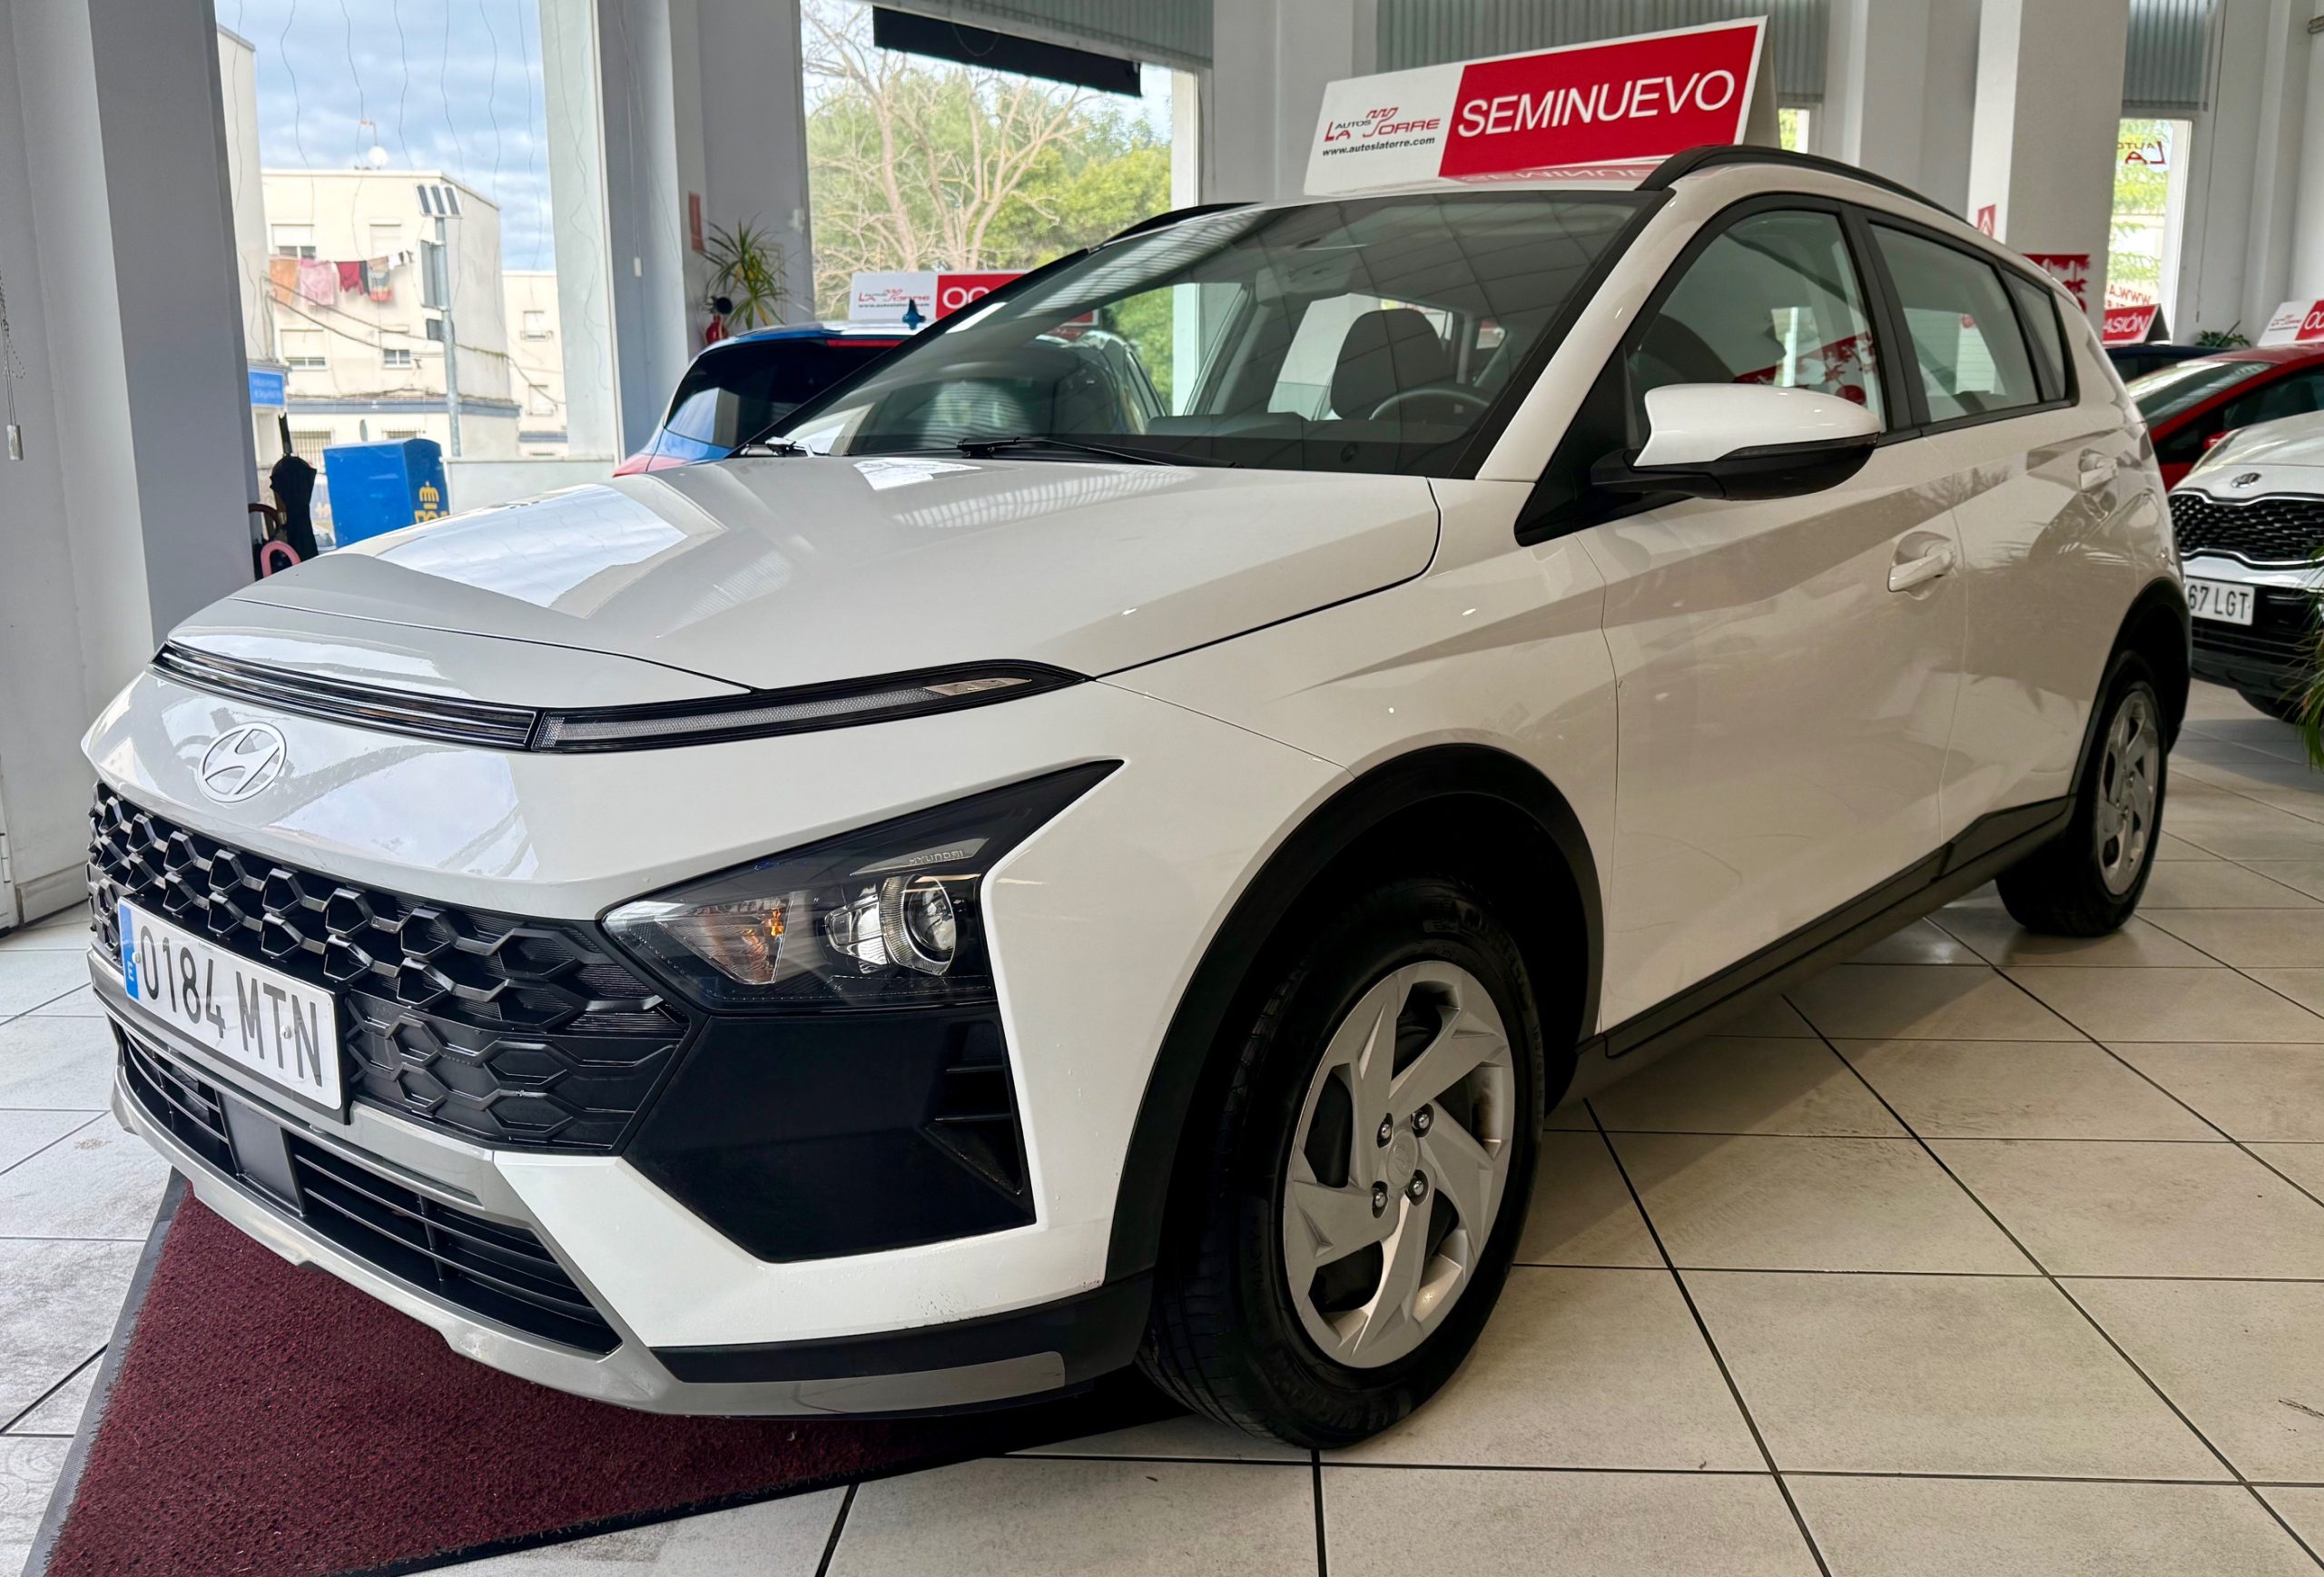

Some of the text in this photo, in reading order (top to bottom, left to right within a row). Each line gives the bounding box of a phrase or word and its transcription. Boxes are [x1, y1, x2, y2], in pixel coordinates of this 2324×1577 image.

[1457, 69, 1735, 138] SEMINUEVO
[1324, 122, 1352, 142] LA
[1334, 119, 1372, 130] AUTOS
[1323, 136, 1435, 157] www.autoslatorre.com
[2214, 587, 2249, 619] LGT
[909, 850, 964, 865] HYUNDAI
[126, 962, 135, 982] E
[140, 925, 323, 1089] 0184 MTN
